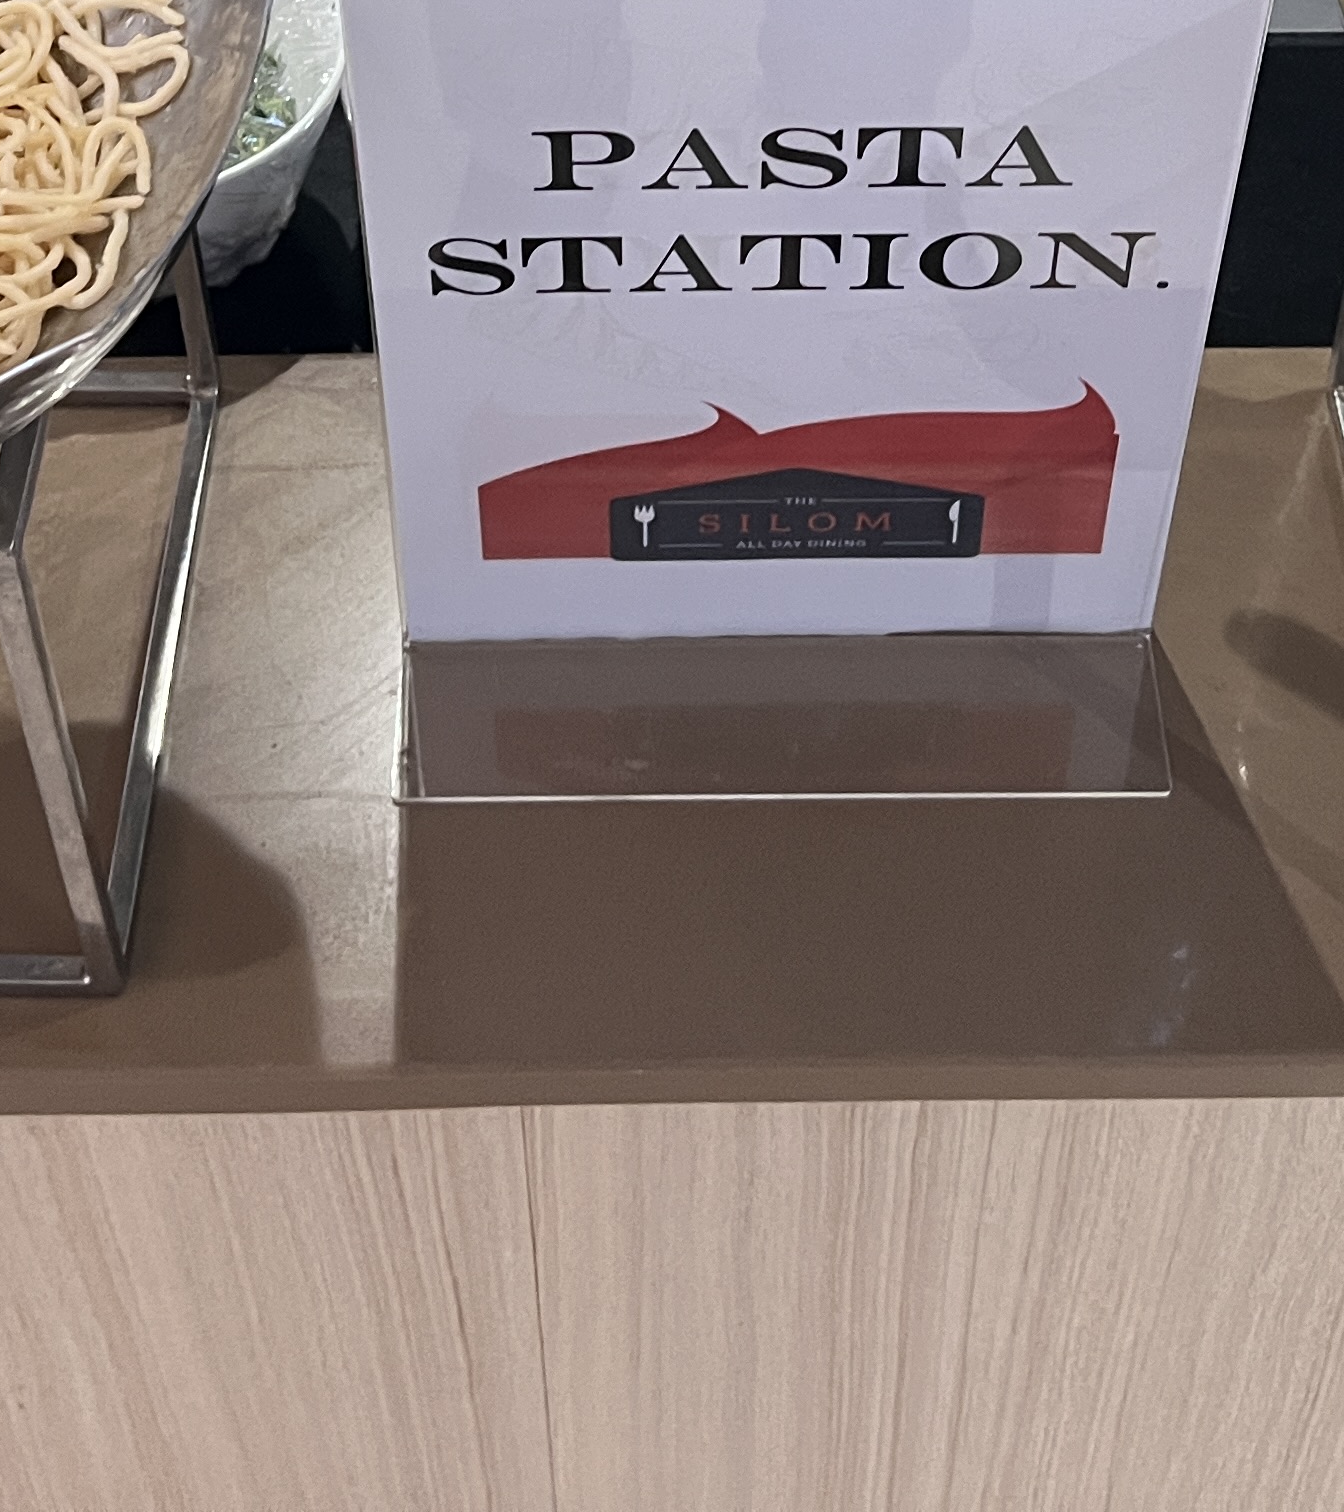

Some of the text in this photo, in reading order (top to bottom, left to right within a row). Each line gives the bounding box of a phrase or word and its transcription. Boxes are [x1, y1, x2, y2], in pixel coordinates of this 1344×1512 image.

[531, 125, 1074, 192] PASTA
[427, 231, 1171, 296] STATION.
[783, 496, 817, 507] THE
[697, 511, 893, 534] SILOM
[735, 539, 867, 549] ALL DAY DINING
